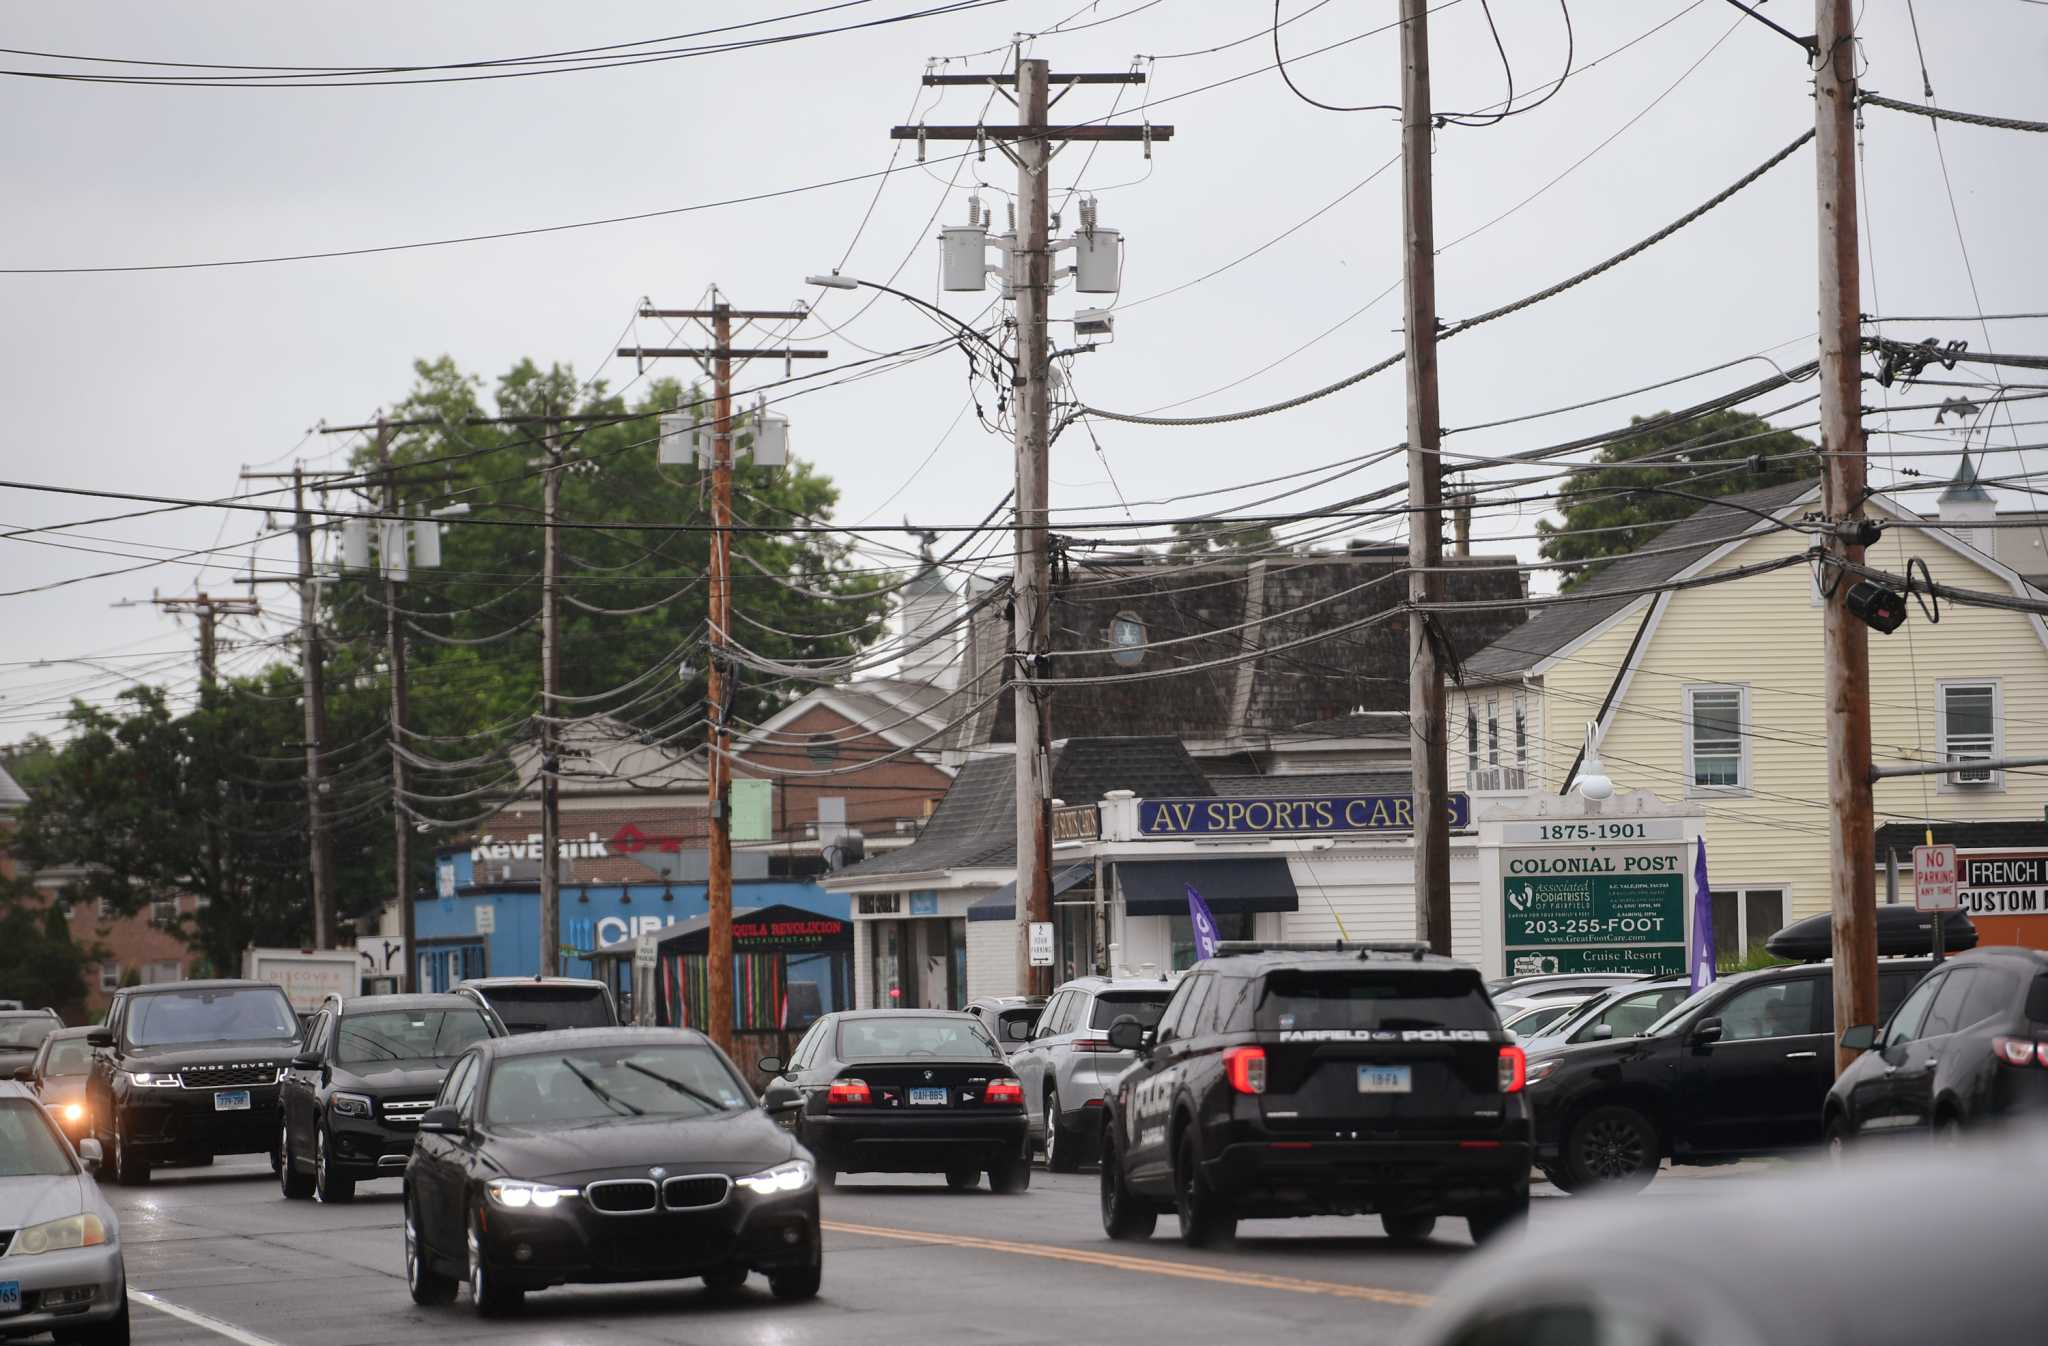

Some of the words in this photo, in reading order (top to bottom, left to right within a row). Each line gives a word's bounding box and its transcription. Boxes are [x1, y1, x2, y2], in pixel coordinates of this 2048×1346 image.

[1151, 803, 1195, 831] AV
[1207, 801, 1333, 830] SPORTS
[1345, 798, 1457, 828] CARS
[1540, 824, 1646, 839] 1875-1901
[1510, 857, 1616, 874] COLONIAL
[1624, 856, 1678, 871] POST
[1926, 852, 1944, 867] NO
[1919, 870, 1954, 883] PARKING
[1972, 861, 2038, 883] FRENCH
[1536, 880, 1589, 891] Associated
[1921, 887, 1934, 896] ANY
[1938, 886, 1952, 896] TIME
[1535, 892, 1590, 902] PODIATRISTS
[1958, 890, 2036, 912] CUSTOM
[771, 921, 841, 935] REVOLUCION
[1524, 918, 1665, 934] 203-255-FOOT
[1544, 935, 1646, 943] www.GreatFootCare.com
[1582, 950, 1621, 961] Cruise
[1624, 949, 1662, 960] Resort
[1280, 1029, 1370, 1042] FAIRFIELD
[1402, 1029, 1489, 1041] POLICE
[231, 1061, 275, 1070] ROVER
